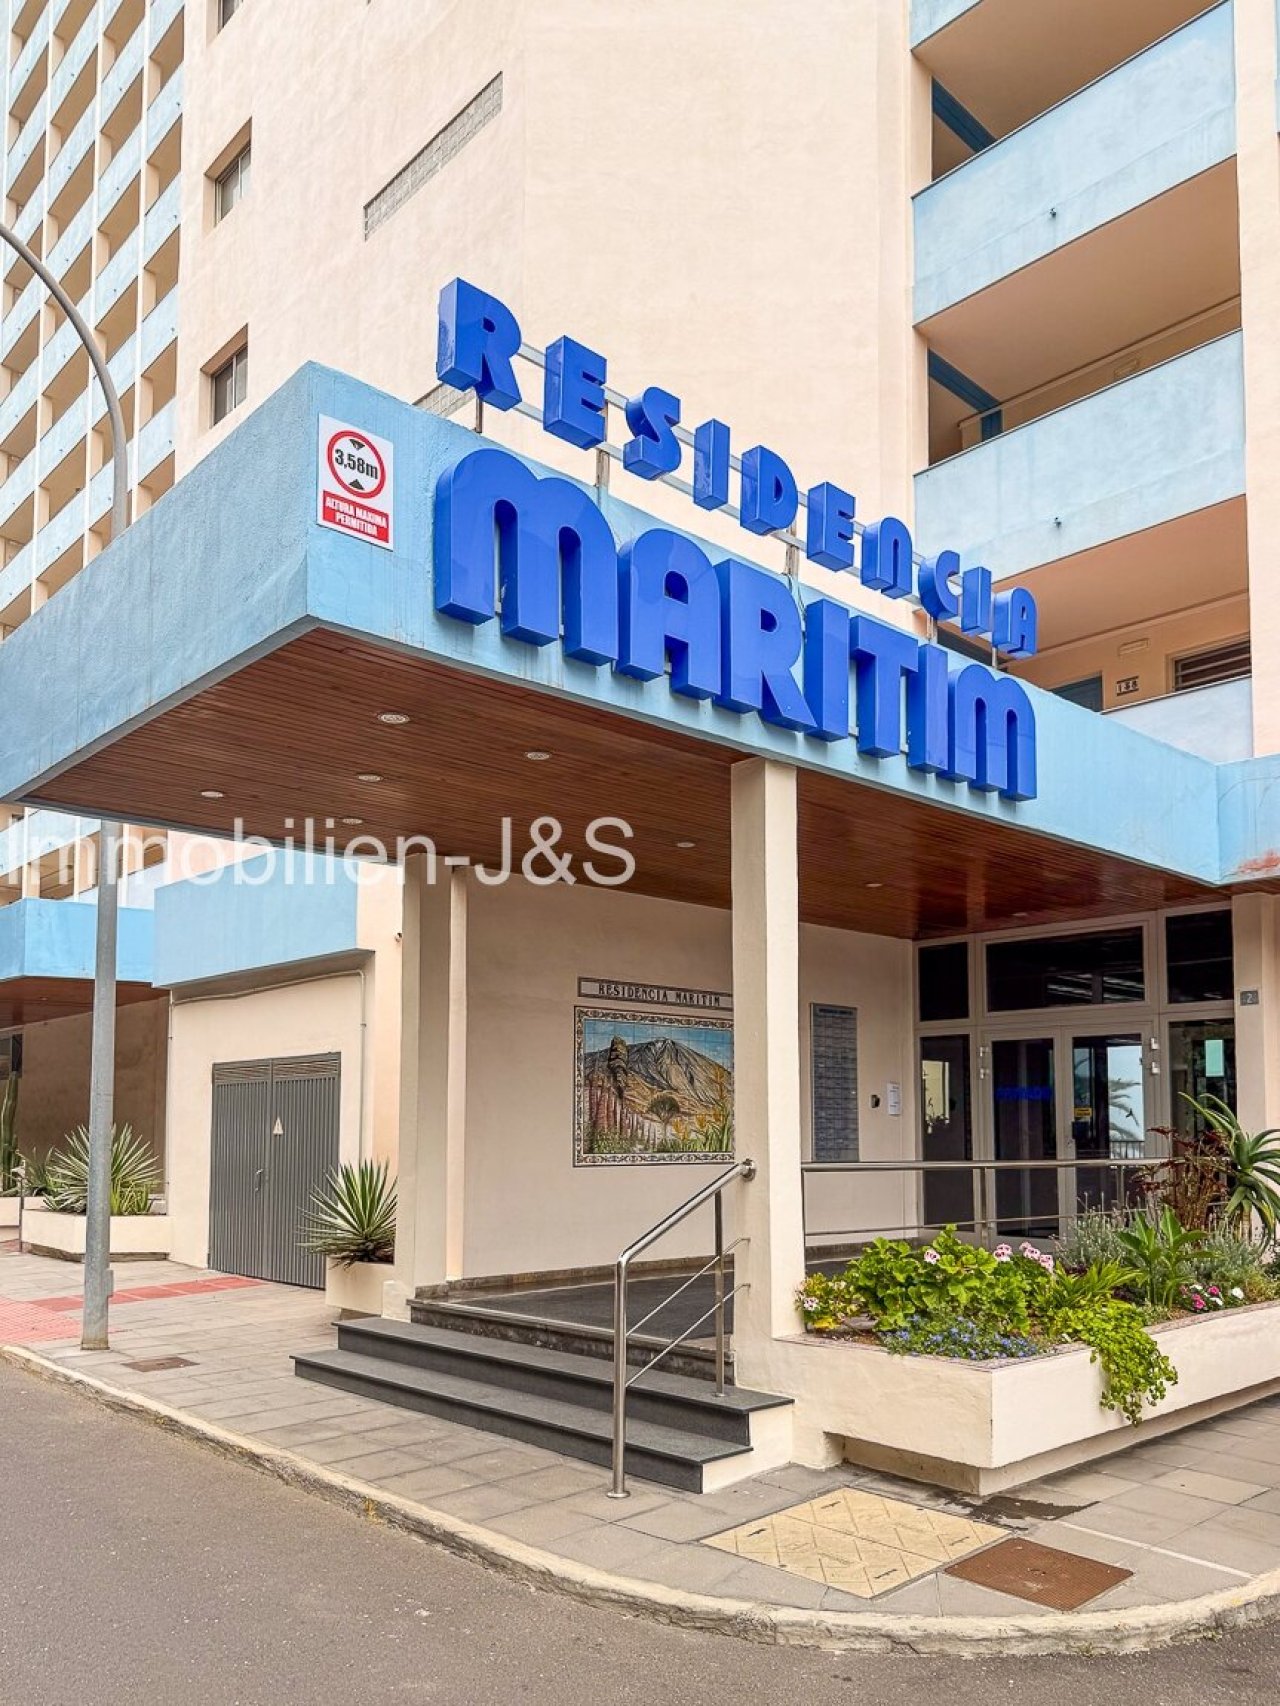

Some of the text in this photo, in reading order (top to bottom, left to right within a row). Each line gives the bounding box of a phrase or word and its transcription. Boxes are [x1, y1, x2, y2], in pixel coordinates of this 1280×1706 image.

[435, 447, 1037, 802] MARITIM
[436, 277, 1037, 658] RESIDENCIA
[598, 983, 721, 1007] RESIDENCIA MARITIM
